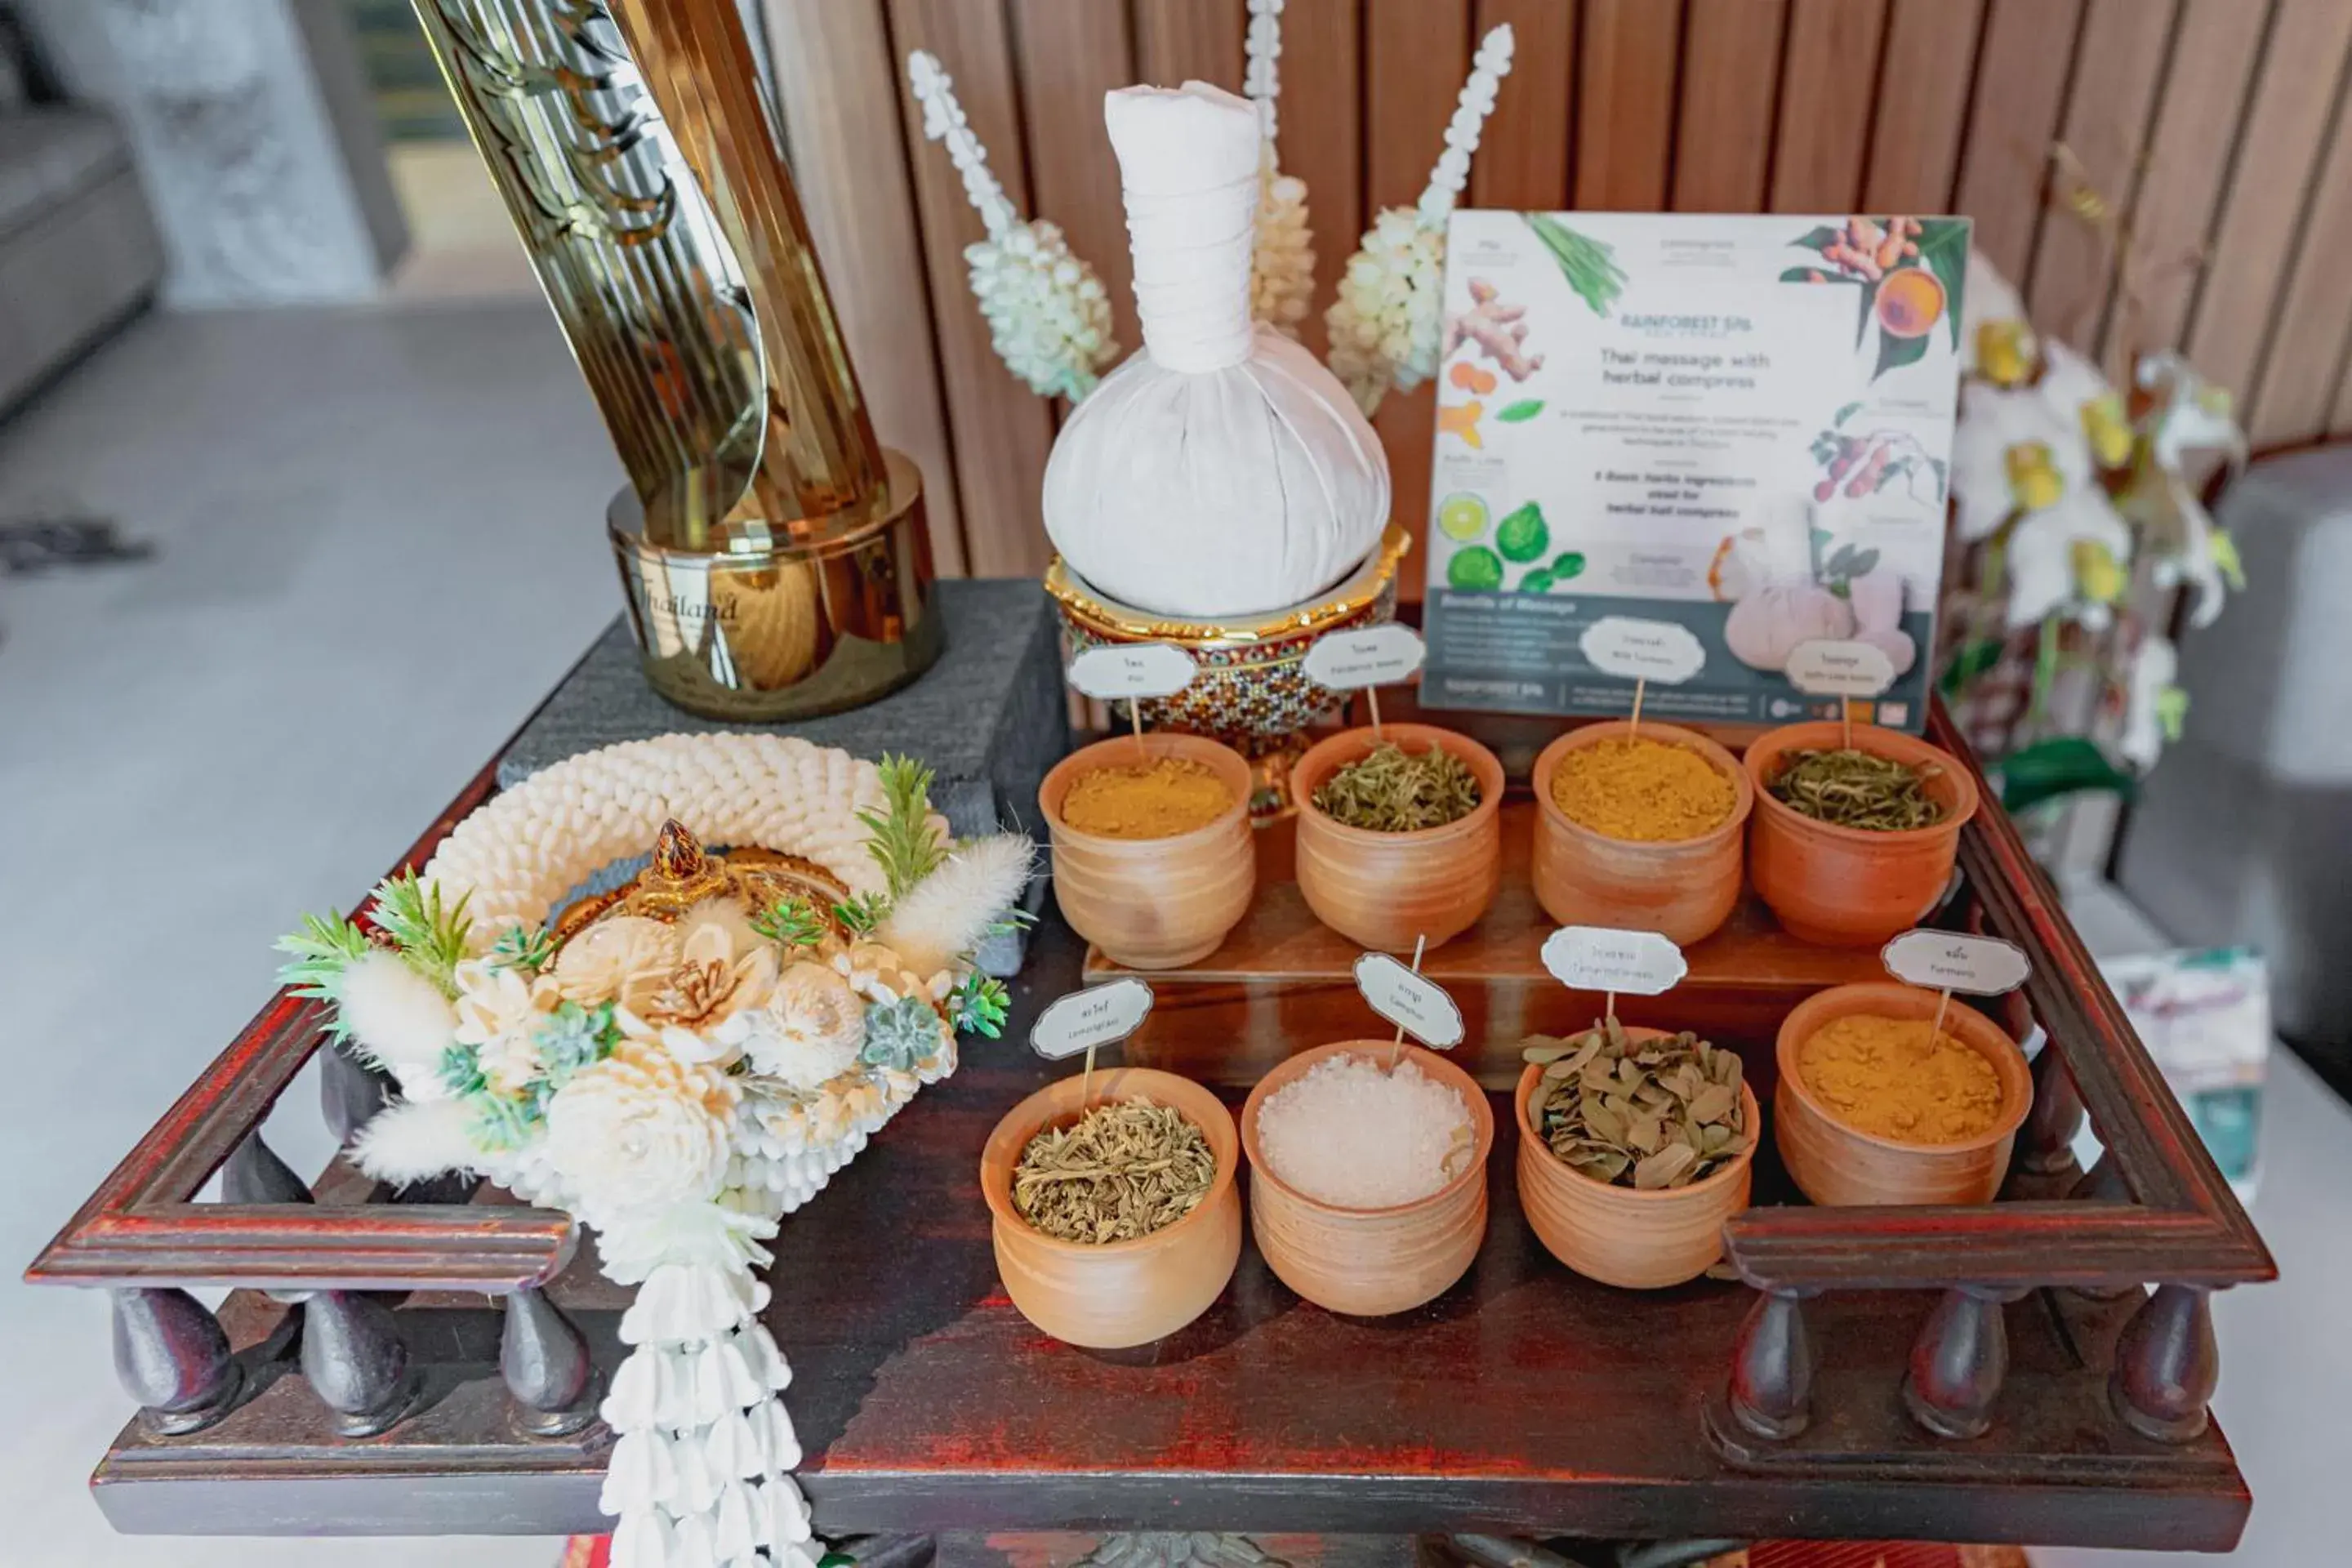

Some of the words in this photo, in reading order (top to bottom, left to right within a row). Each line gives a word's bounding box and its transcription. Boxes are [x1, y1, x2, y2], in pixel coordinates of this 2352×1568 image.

[1620, 314, 1718, 330] RAINFOREST
[1601, 348, 1637, 366] Thai
[1643, 354, 1723, 371] massage
[1731, 351, 1771, 368] with
[1602, 369, 1661, 385] herbal
[1667, 373, 1756, 390] compress
[632, 573, 737, 620] Thailand
[1499, 597, 1514, 610] of
[1516, 598, 1577, 615] Massage
